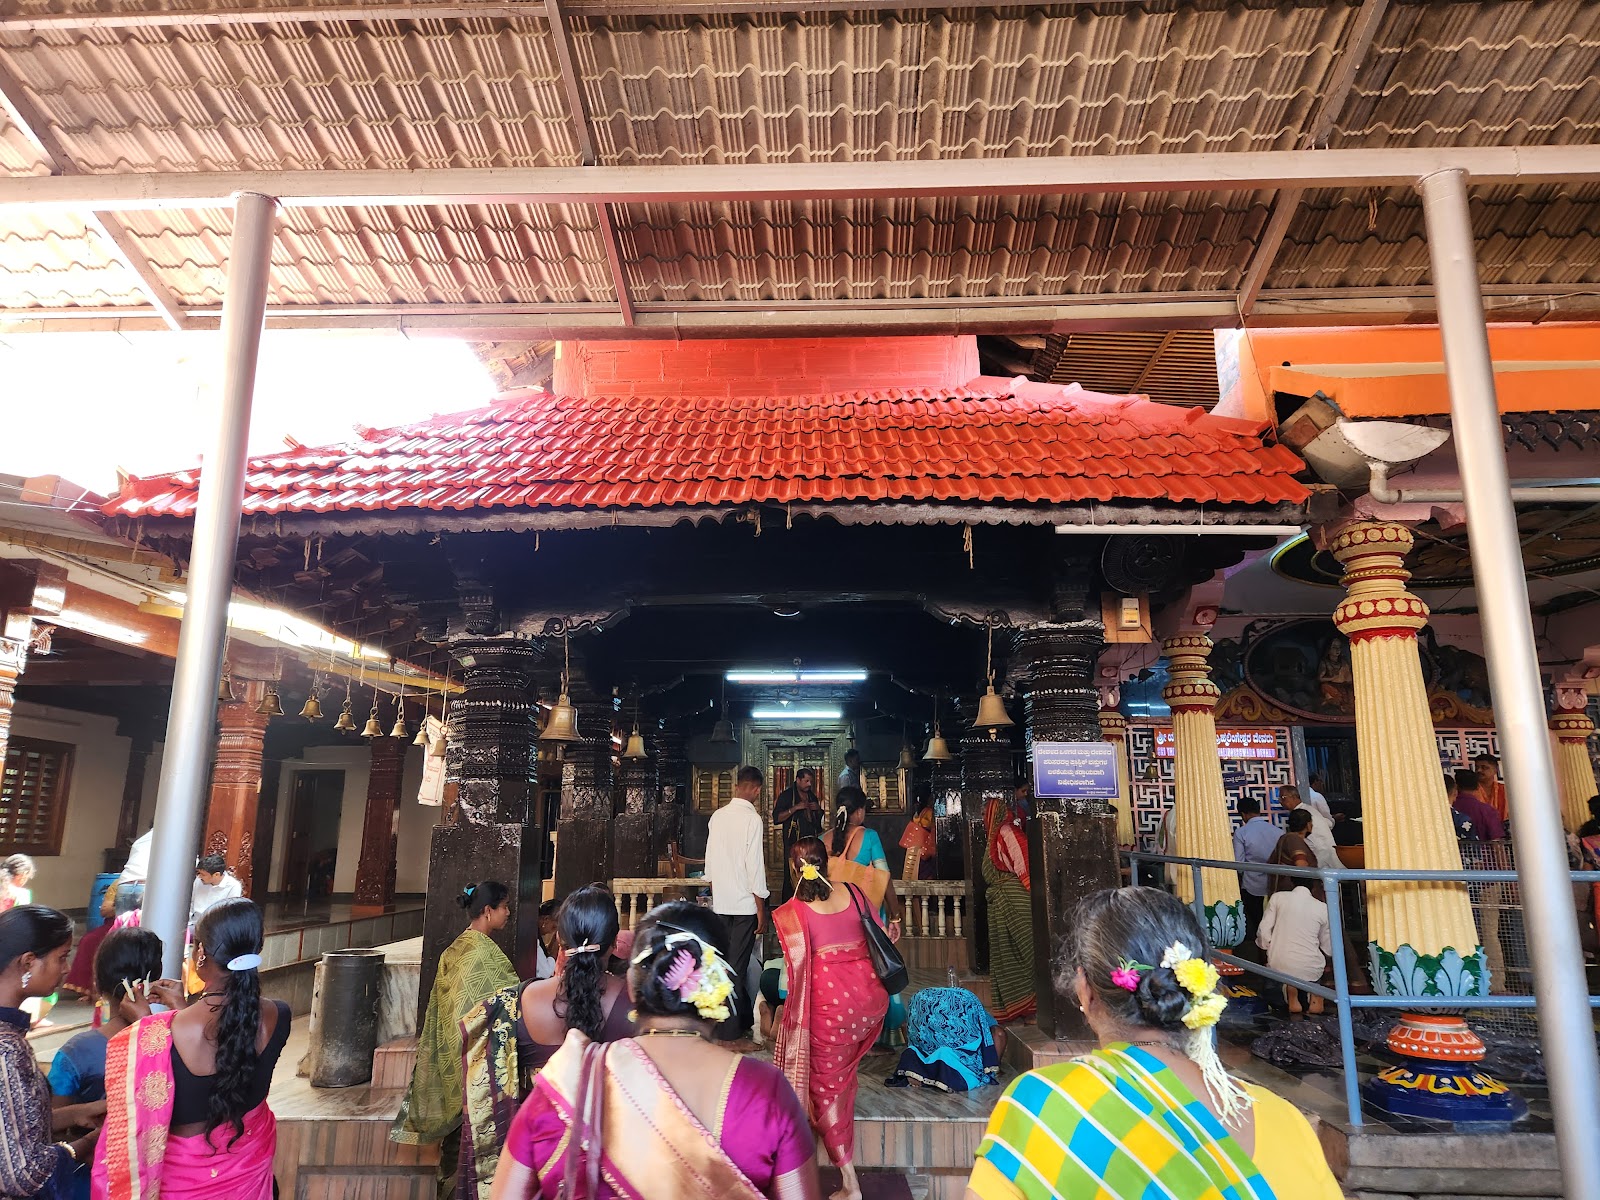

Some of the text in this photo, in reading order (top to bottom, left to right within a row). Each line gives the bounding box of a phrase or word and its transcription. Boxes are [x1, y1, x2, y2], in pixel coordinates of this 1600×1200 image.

[1156, 731, 1167, 745] ಶ್ರೀ
[1253, 732, 1274, 744] ದೇವರು
[1077, 749, 1090, 757] ಮತ್ತು
